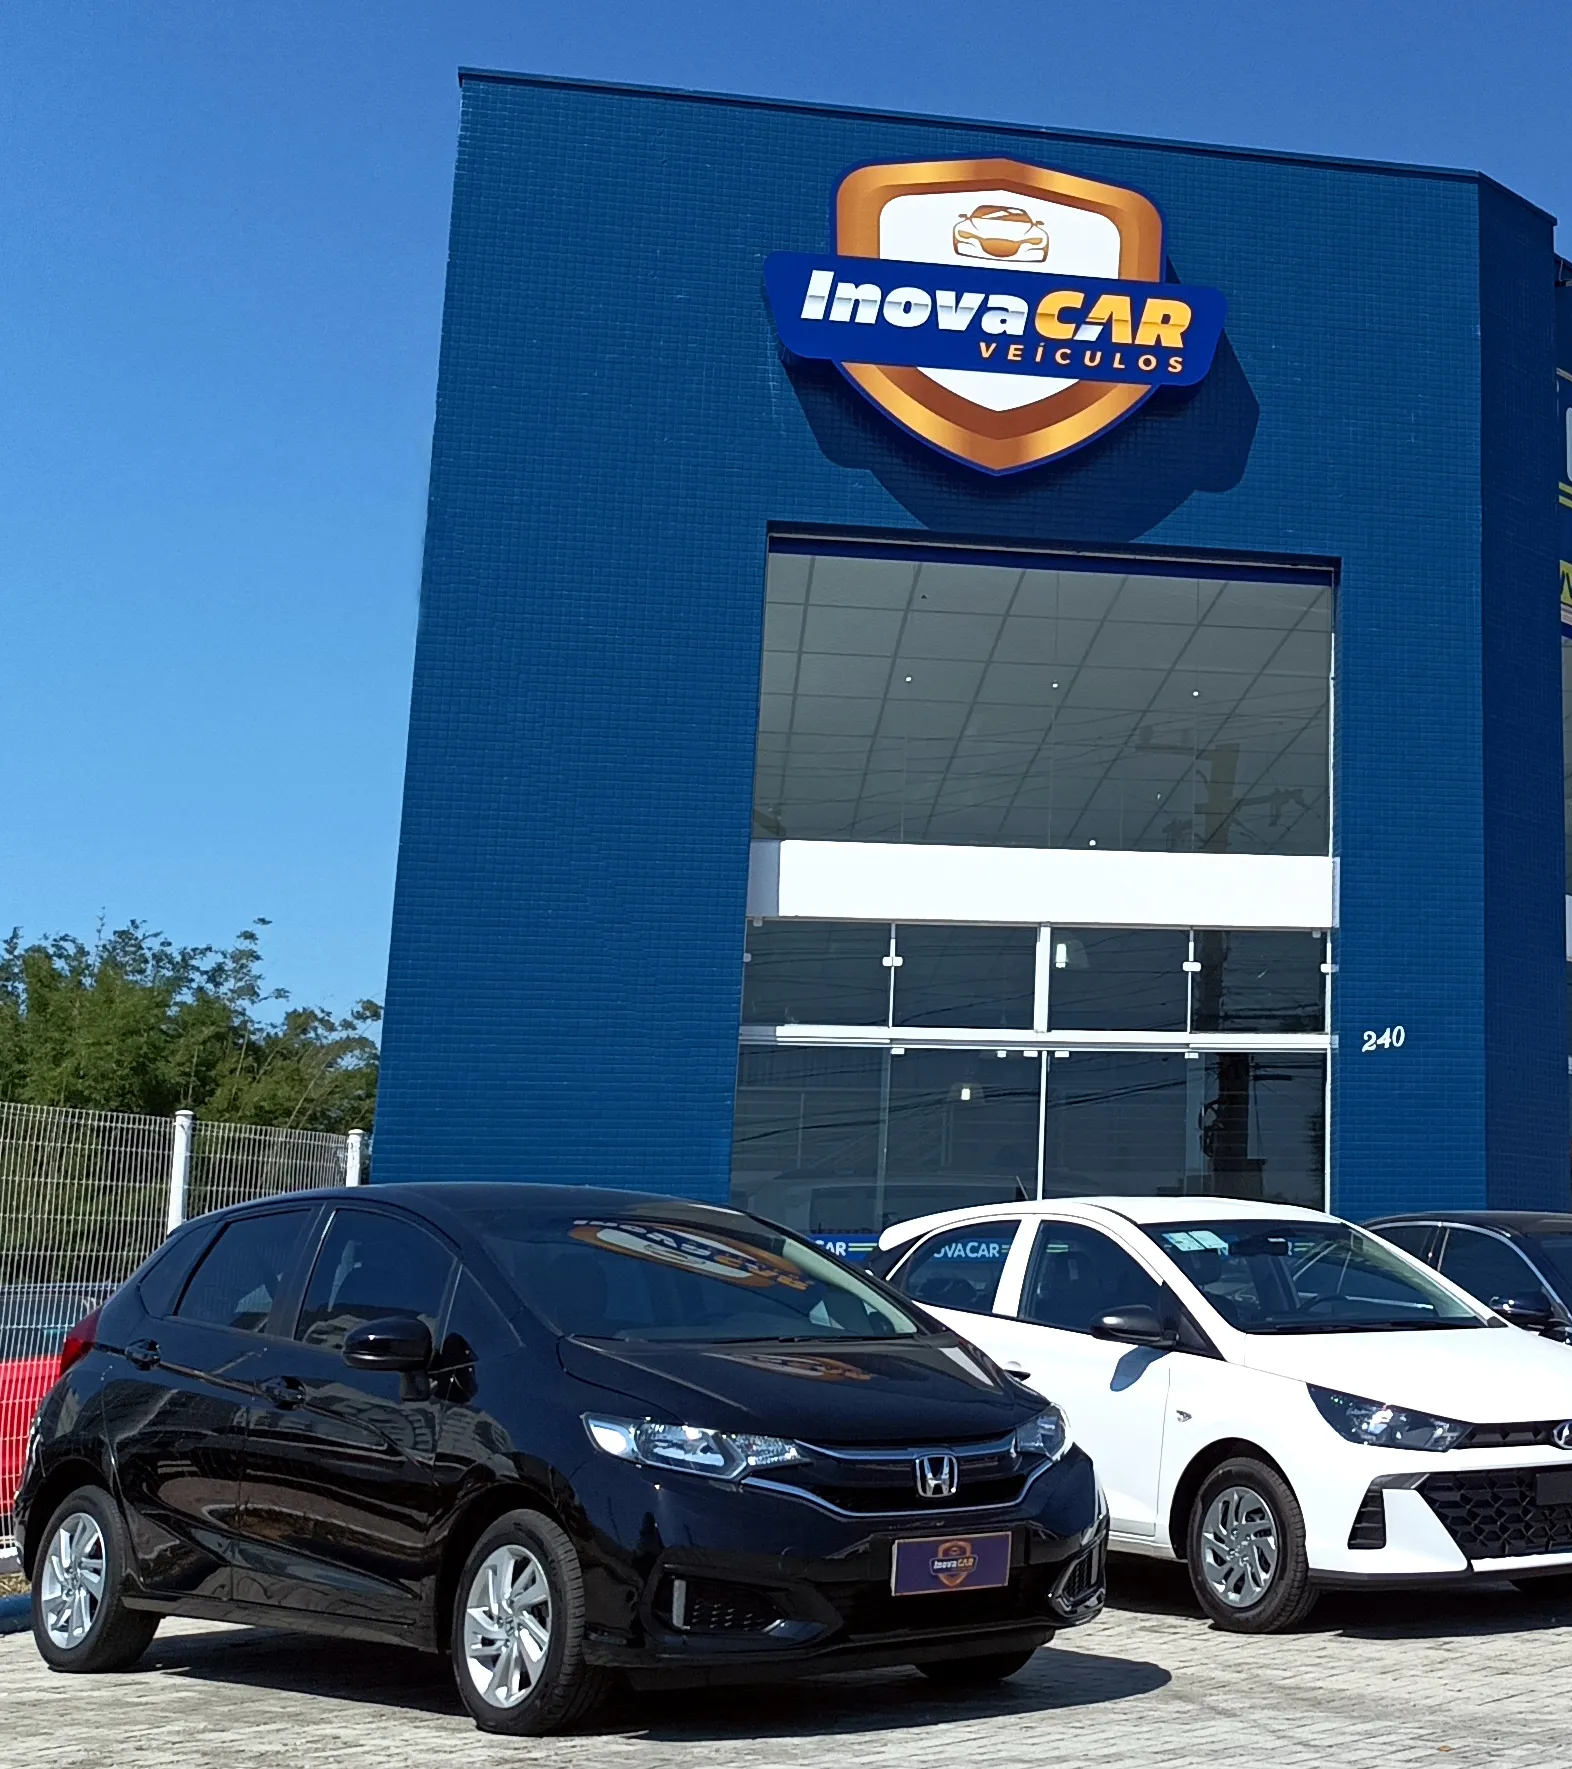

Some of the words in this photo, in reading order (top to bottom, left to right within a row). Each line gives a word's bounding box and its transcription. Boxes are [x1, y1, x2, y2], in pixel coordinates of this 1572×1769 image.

[800, 269, 1192, 348] InovaCAR
[979, 341, 1183, 373] VEÍCULOS
[1361, 1025, 1406, 1053] 240
[814, 1239, 847, 1257] AR
